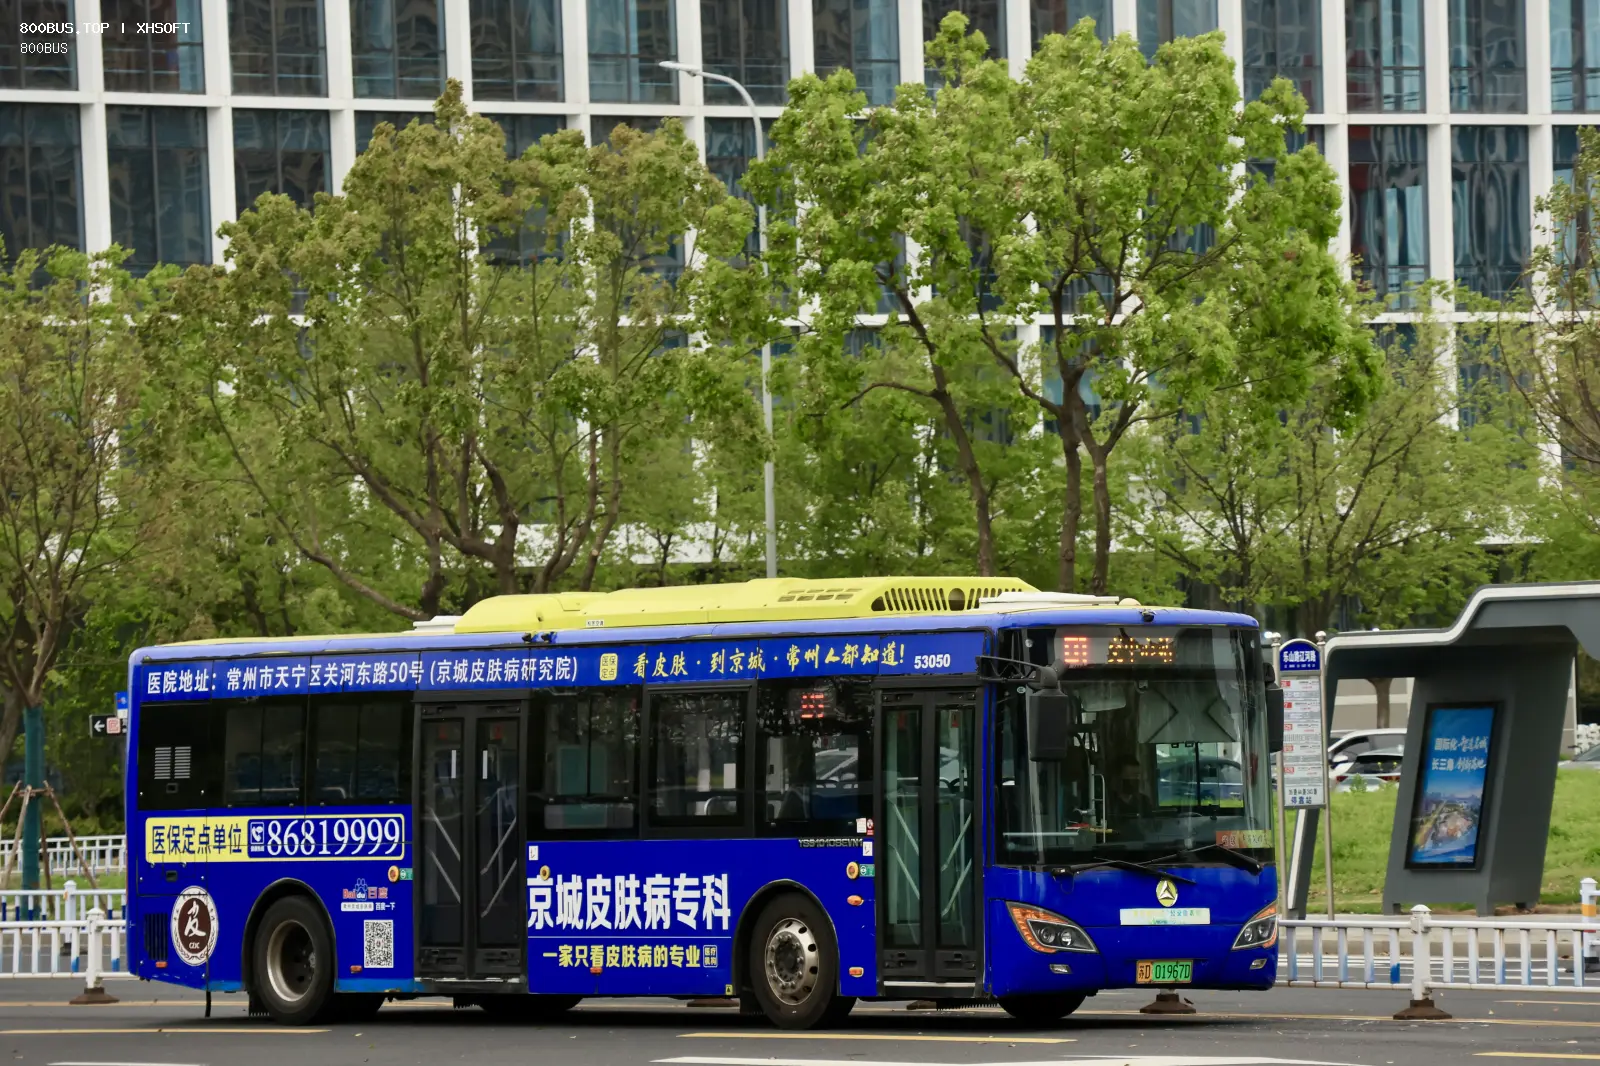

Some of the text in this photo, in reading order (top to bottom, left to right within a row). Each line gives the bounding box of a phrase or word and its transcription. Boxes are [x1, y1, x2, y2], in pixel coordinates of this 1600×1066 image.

[914, 653, 951, 669] 53050
[152, 818, 400, 856] 医保定点单位 86819999
[367, 886, 389, 899] 百度
[375, 902, 396, 911] 百度一下
[527, 873, 731, 930] 京城皮肤病专科
[543, 944, 700, 968] 一家只看皮肤病的专业
[1138, 964, 1191, 980] 苏D 01967D
